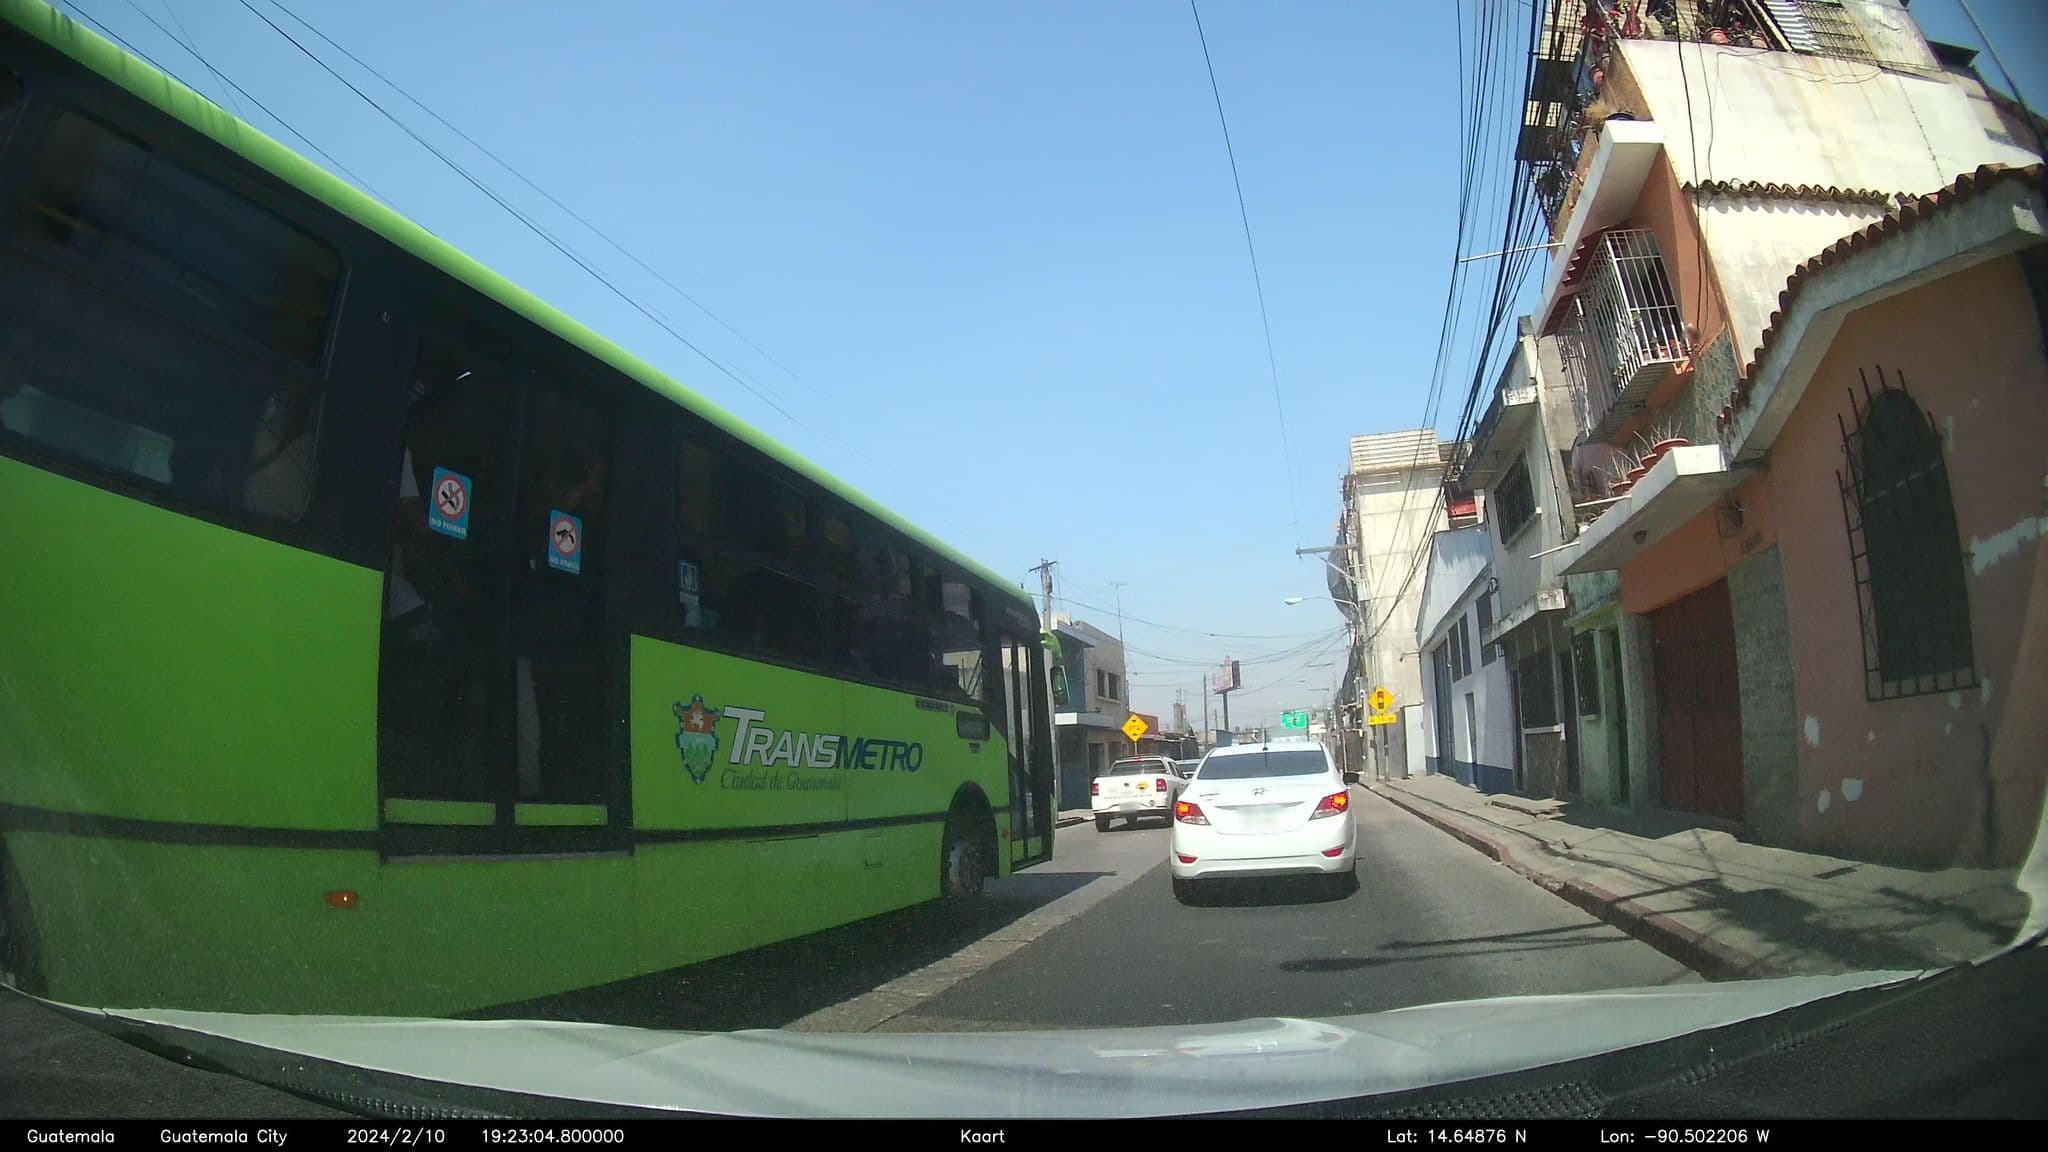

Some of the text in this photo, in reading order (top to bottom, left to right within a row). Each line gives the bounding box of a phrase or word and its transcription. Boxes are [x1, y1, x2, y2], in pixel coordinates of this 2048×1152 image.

[431, 518, 442, 528] NO
[720, 767, 768, 791] Ciudad
[768, 768, 784, 791] de
